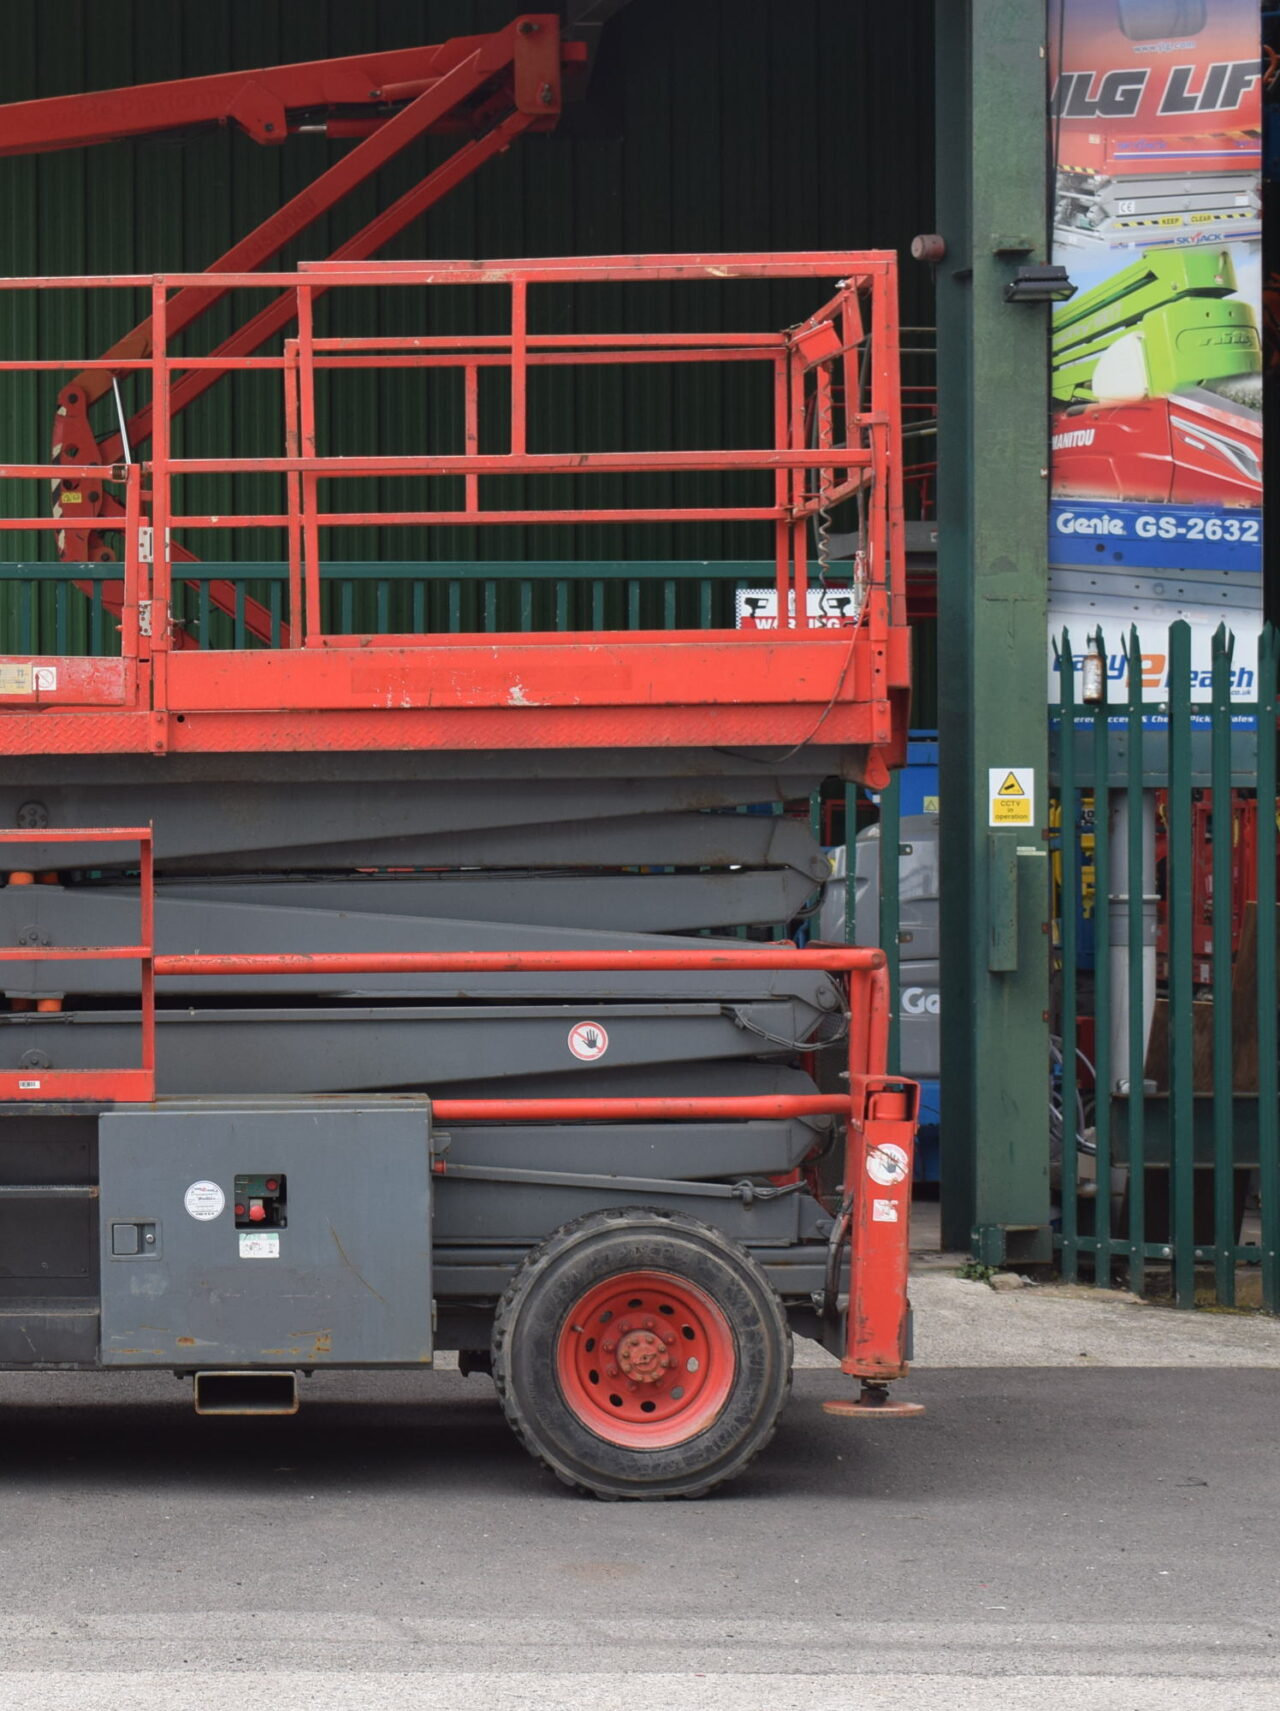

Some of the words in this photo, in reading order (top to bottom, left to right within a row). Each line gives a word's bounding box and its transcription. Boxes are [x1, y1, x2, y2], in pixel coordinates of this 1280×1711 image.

[1050, 67, 1152, 119] JLG
[1162, 217, 1180, 226] KEEP
[1191, 215, 1212, 223] CLEAR
[1174, 232, 1222, 244] SKYJACK
[1056, 512, 1125, 535] Genie
[1135, 516, 1259, 542] GS-2632
